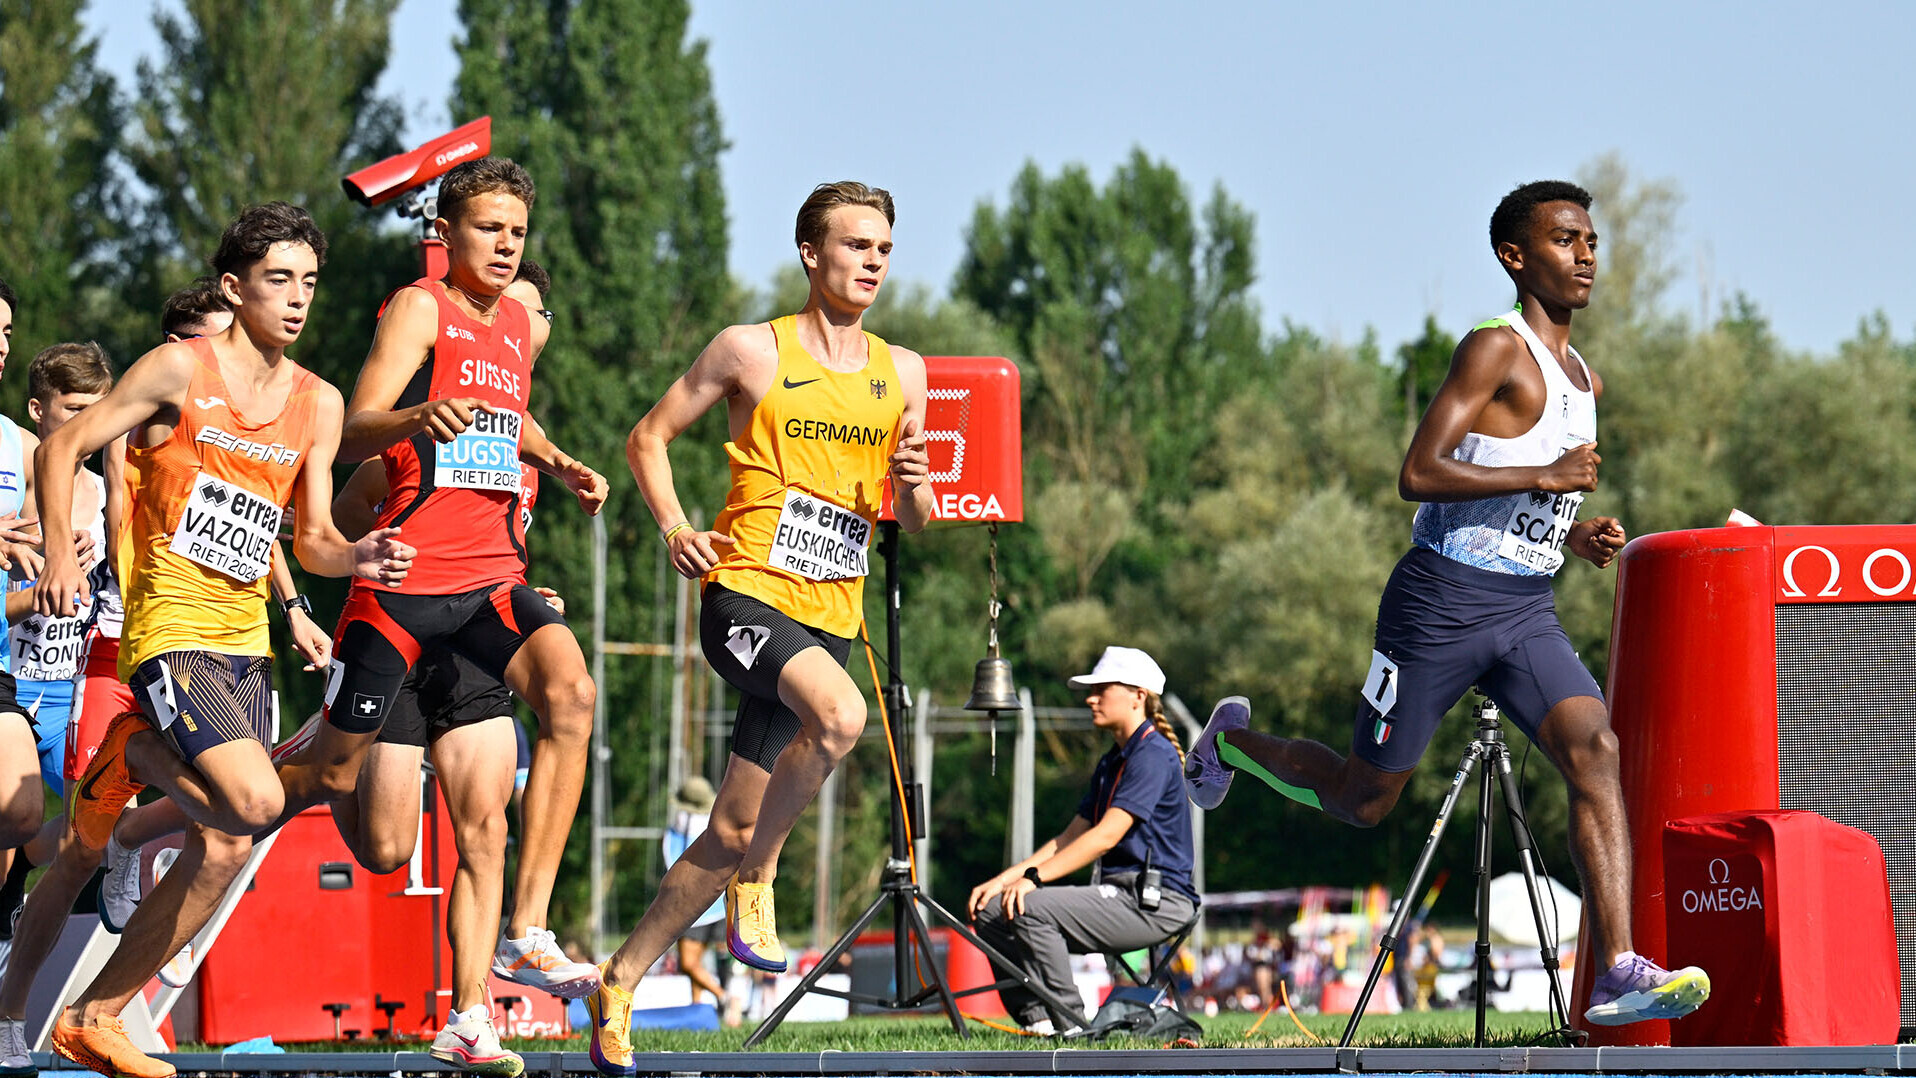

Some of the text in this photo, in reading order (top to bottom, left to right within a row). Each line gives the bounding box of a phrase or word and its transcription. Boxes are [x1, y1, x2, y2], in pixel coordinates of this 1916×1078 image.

[195, 425, 301, 467] ESPAÑA
[785, 418, 889, 447] GERMANY
[452, 469, 491, 484] RIETI
[230, 492, 278, 535] errea
[817, 506, 869, 547] errea
[185, 507, 271, 566] VAZQUEZ
[775, 523, 866, 575] EUSKIRCHEN
[188, 542, 230, 568] RIETI
[784, 554, 823, 577] RIETI
[45, 619, 82, 641] erre
[19, 665, 52, 680] RIETI
[1374, 666, 1393, 703] 1
[1682, 886, 1763, 913] OMEGA
